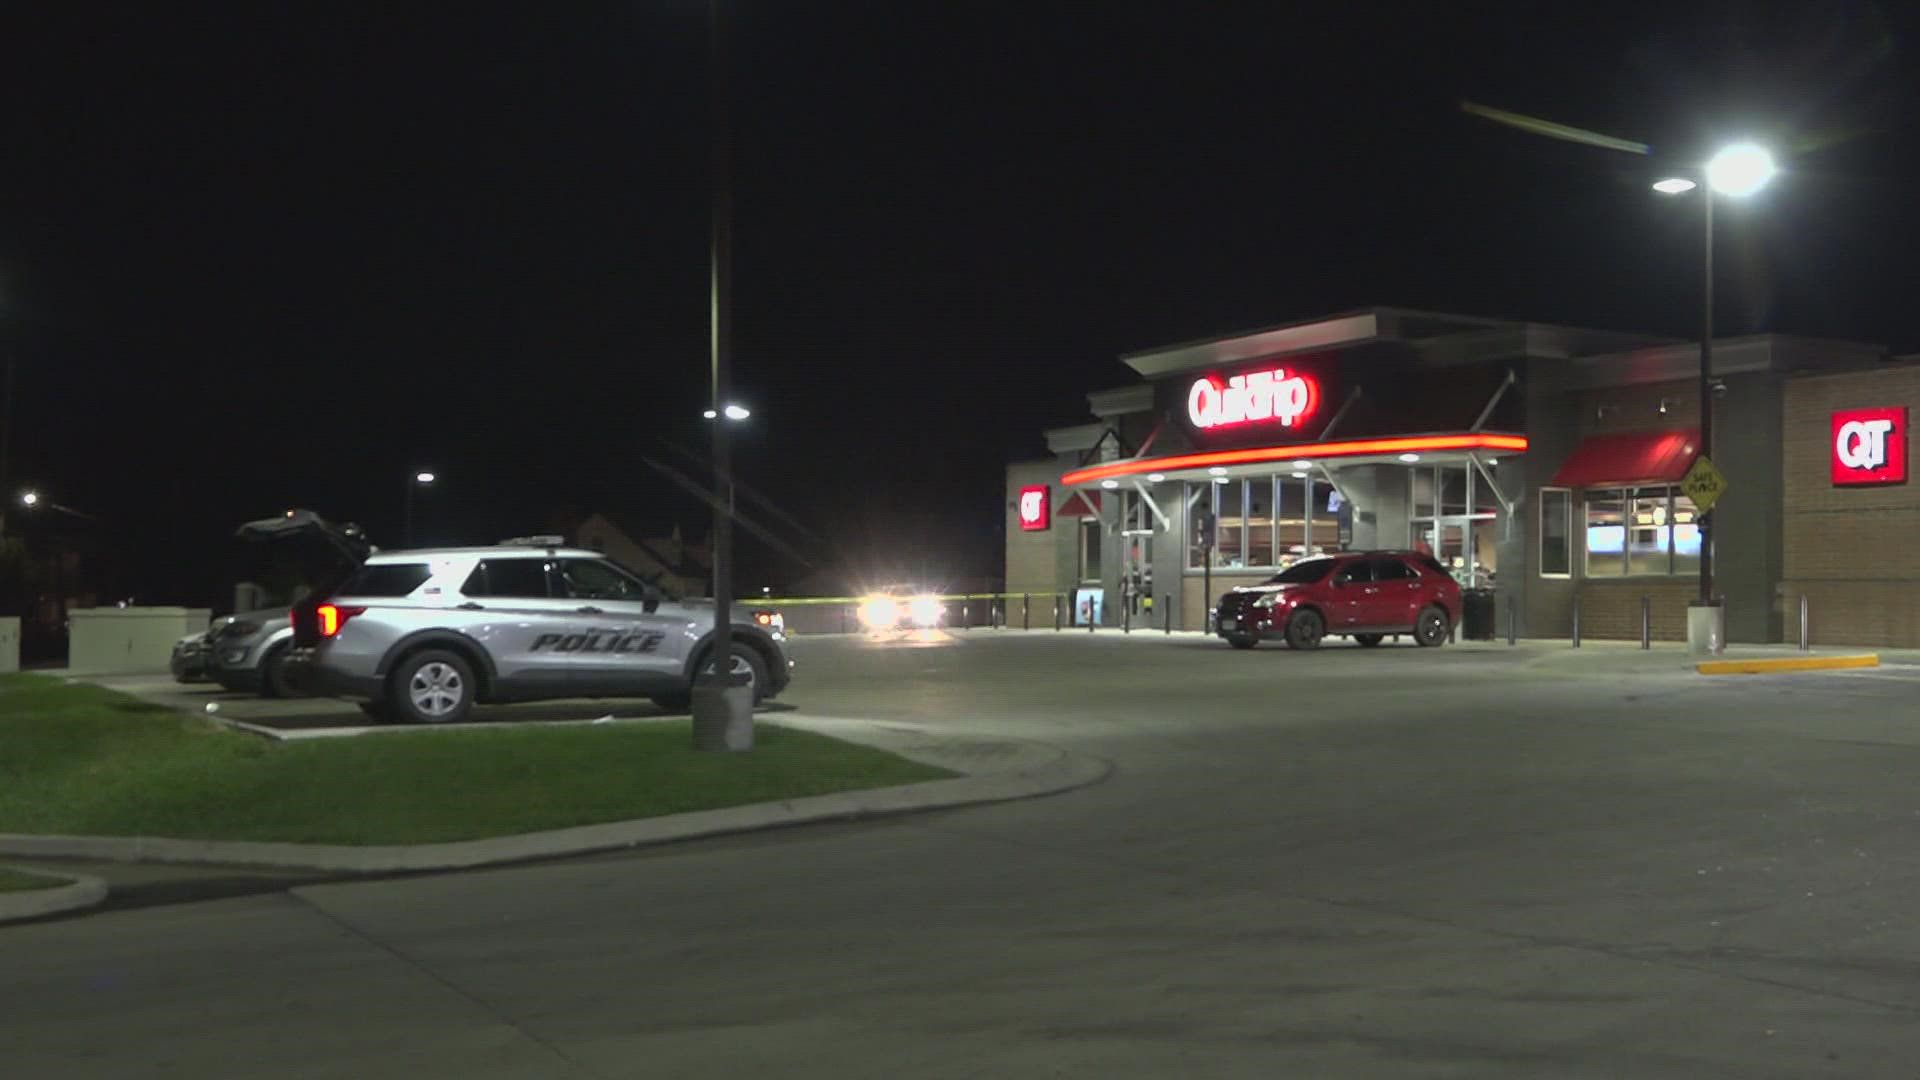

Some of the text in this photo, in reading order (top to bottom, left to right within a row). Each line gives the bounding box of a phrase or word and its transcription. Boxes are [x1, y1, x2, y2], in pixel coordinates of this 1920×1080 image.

[1188, 368, 1308, 428] QuikTrip
[1836, 419, 1892, 470] QT
[1020, 491, 1044, 523] QT
[527, 630, 666, 653] POLICE
